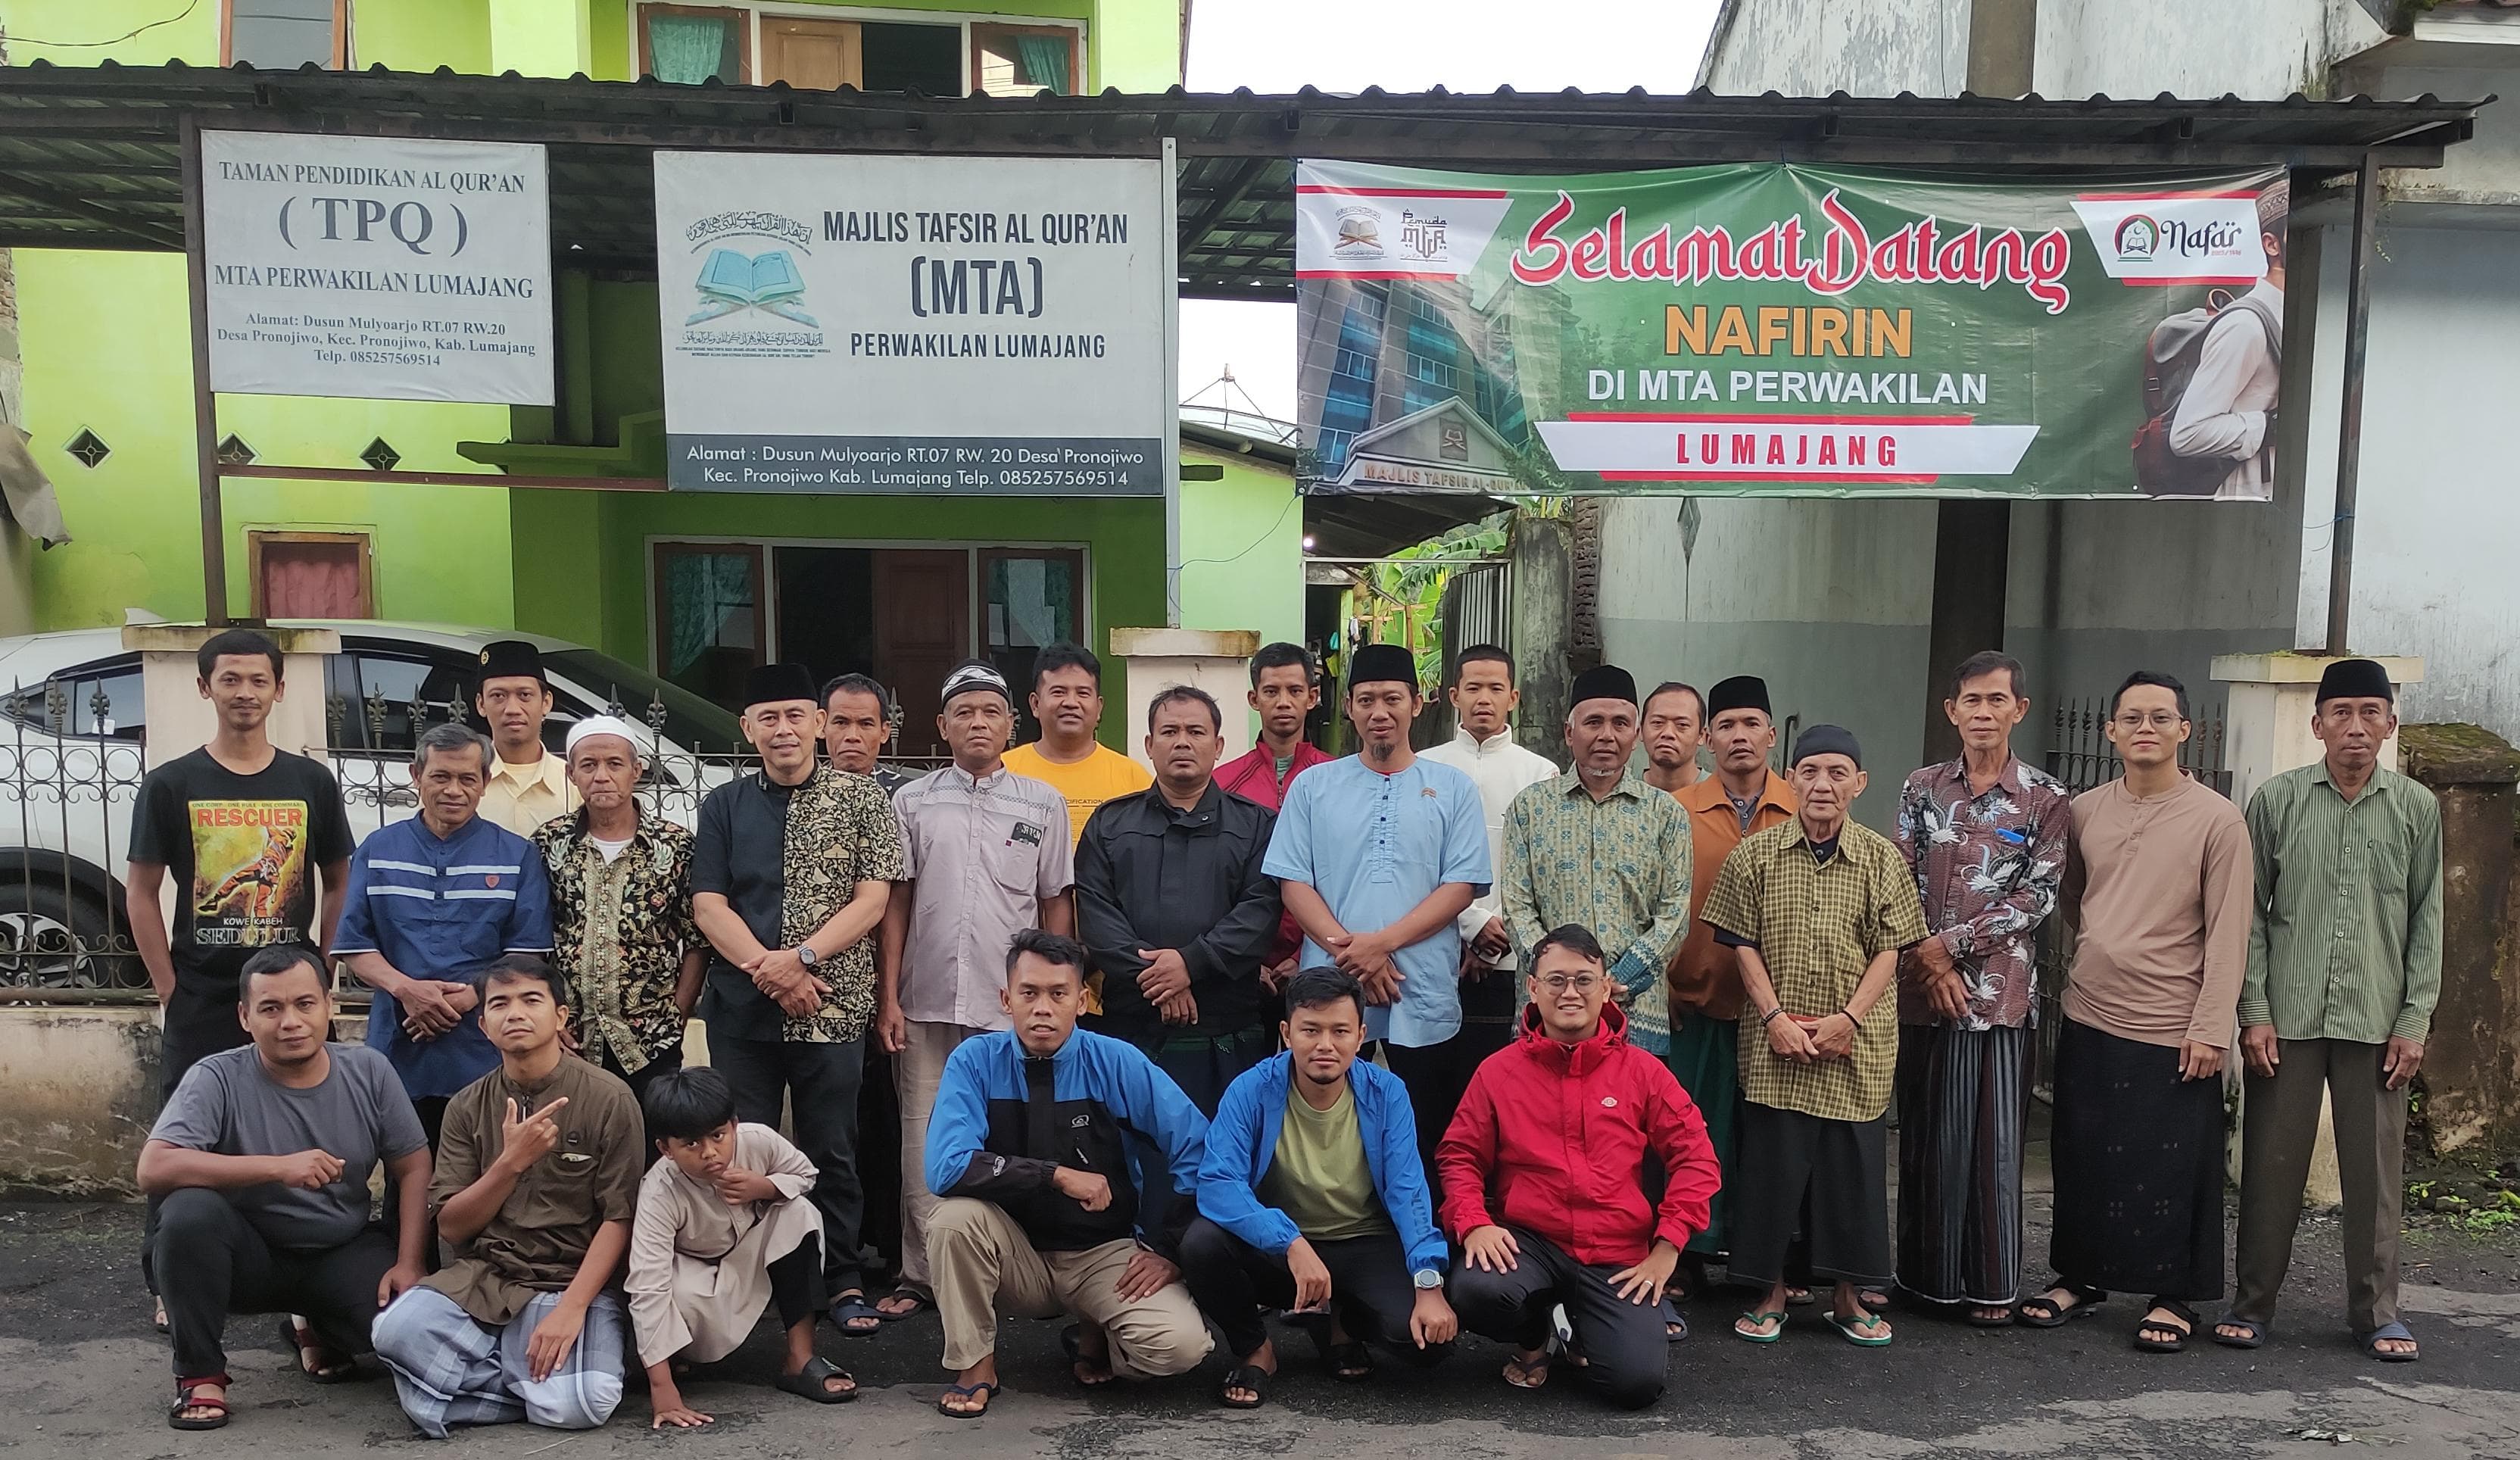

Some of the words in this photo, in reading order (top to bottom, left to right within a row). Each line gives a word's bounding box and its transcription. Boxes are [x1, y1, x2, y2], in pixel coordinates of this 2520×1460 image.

[219, 161, 289, 182] TAMAN
[295, 165, 416, 189] PENDIDIKAN
[421, 171, 445, 190] AL
[450, 172, 525, 195] QUR'AN
[823, 211, 908, 242] MAJLIS
[915, 212, 996, 243] TAFSIR
[1005, 213, 1034, 243] AL
[1041, 214, 1127, 247] QUR'AN
[1510, 189, 1810, 286] Selamat
[1804, 188, 2071, 314] Datang
[214, 265, 261, 286] MTA
[267, 267, 408, 293] PERWAKILAN
[414, 273, 533, 299] LUMAJANG
[911, 256, 1043, 318] (MTA)
[245, 313, 299, 327] Alamat:
[304, 315, 344, 329] Dusun
[349, 317, 418, 334] Mulyoarjo
[423, 320, 459, 333] RT.07
[463, 323, 506, 335] RW.20
[1665, 304, 1912, 357] NAFIRIN
[217, 328, 248, 342] Desa
[252, 329, 323, 347] Pronojiwo,
[327, 332, 356, 346] Kec.
[360, 335, 431, 351] Pronojiwo,
[435, 338, 465, 351] Kab.
[469, 339, 536, 357] Lumajang
[851, 332, 987, 357] PERWAKILAN
[994, 334, 1106, 358] LUMAJANG
[313, 349, 346, 364] Telp.
[350, 352, 441, 367] 085257569514
[1589, 370, 1625, 401] DI
[1639, 370, 1719, 401] MTA
[1730, 371, 1987, 404] PERWAKILAN
[687, 445, 746, 461] Alamat
[763, 446, 815, 462] Dusun
[821, 448, 901, 466] Mulyoarjo
[907, 448, 950, 463] RT.07
[956, 448, 984, 463] RW.
[990, 449, 1012, 463] 20
[1018, 448, 1059, 464] Desa
[1065, 449, 1143, 468] Pronojiwo
[1676, 433, 1897, 466] LUMAJANG
[704, 467, 738, 483] Kec.
[744, 468, 824, 487] Pronojiwo
[830, 469, 865, 485] Kab.
[872, 470, 952, 488] Lumajang
[956, 470, 994, 489] Telp.
[1000, 470, 1129, 486] 085257569514
[1364, 463, 1420, 483] MAJLIS
[1425, 473, 1469, 488] TAFSIR
[197, 809, 302, 827] RESCUER
[223, 917, 251, 925] KOWE
[254, 917, 283, 925] KABEH
